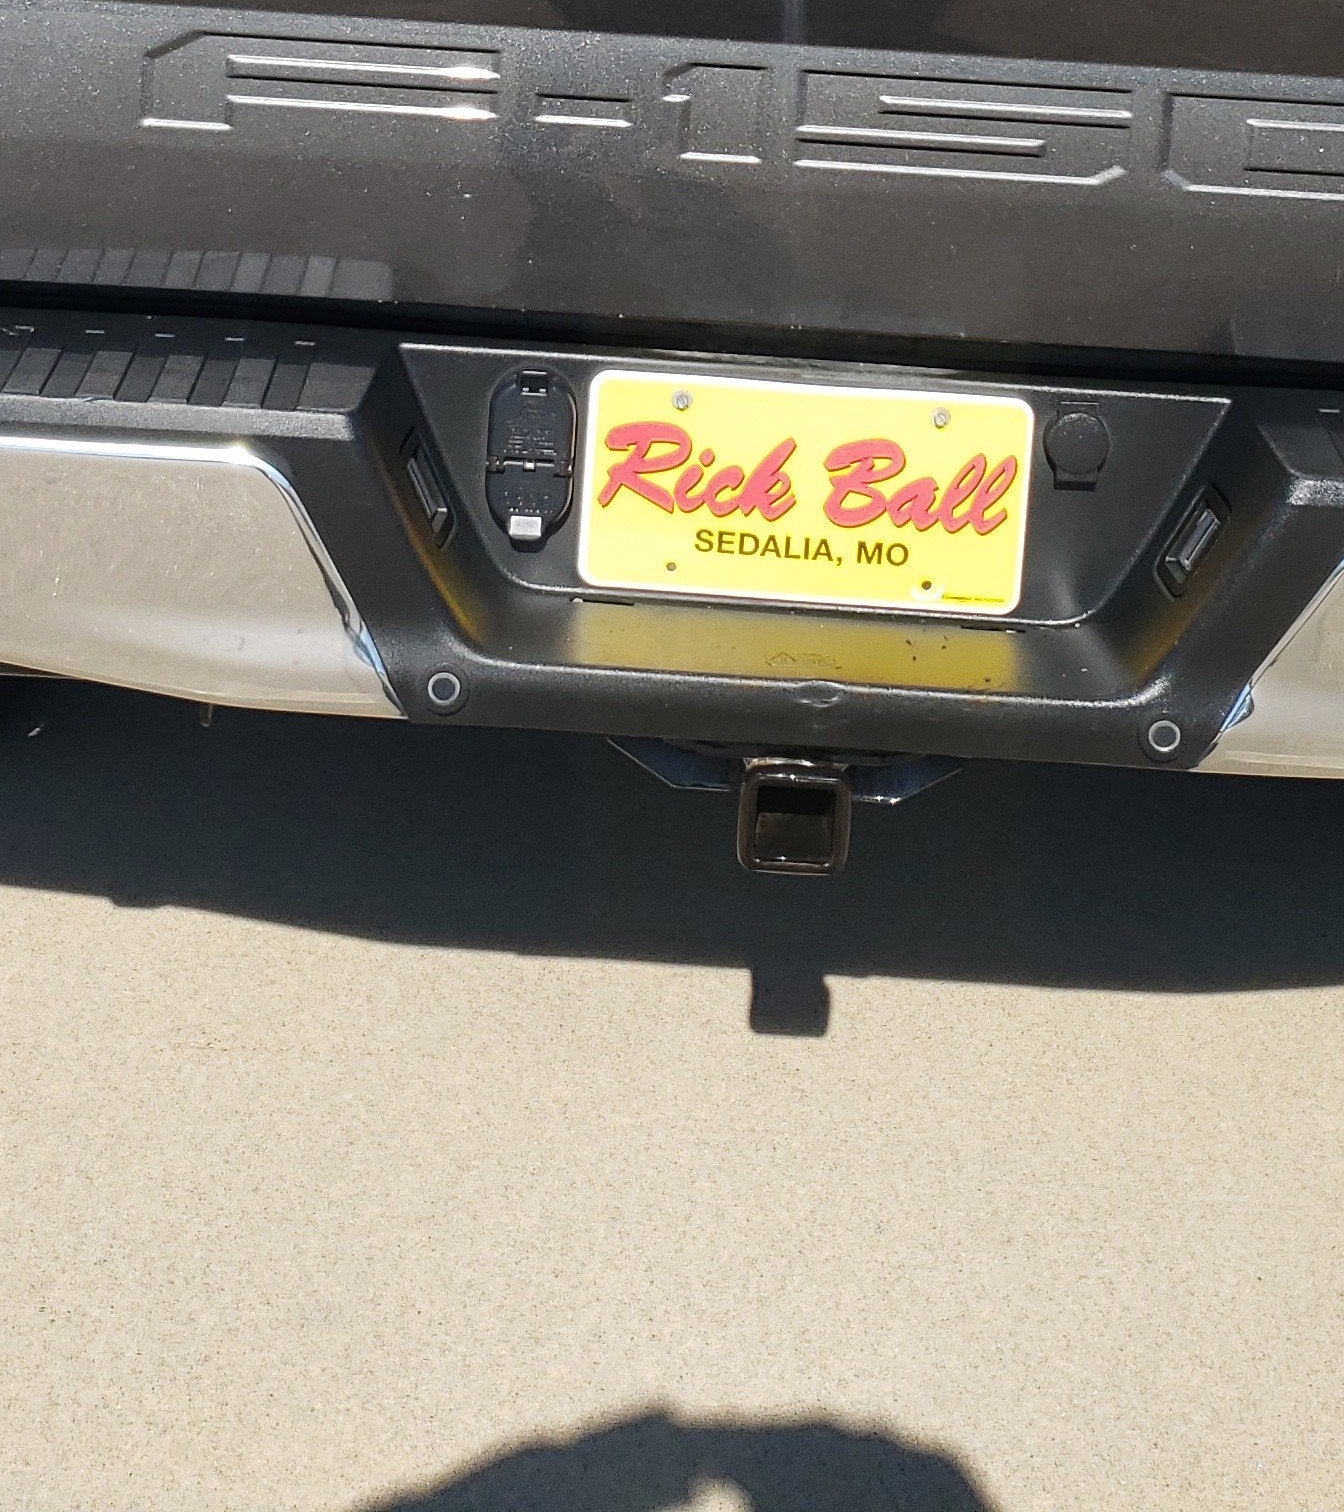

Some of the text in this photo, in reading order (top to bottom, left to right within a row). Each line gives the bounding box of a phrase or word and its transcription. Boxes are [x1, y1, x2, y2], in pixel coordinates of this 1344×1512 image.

[597, 420, 1018, 536] Rick Ball
[694, 528, 909, 567] SEDALIA, MO
